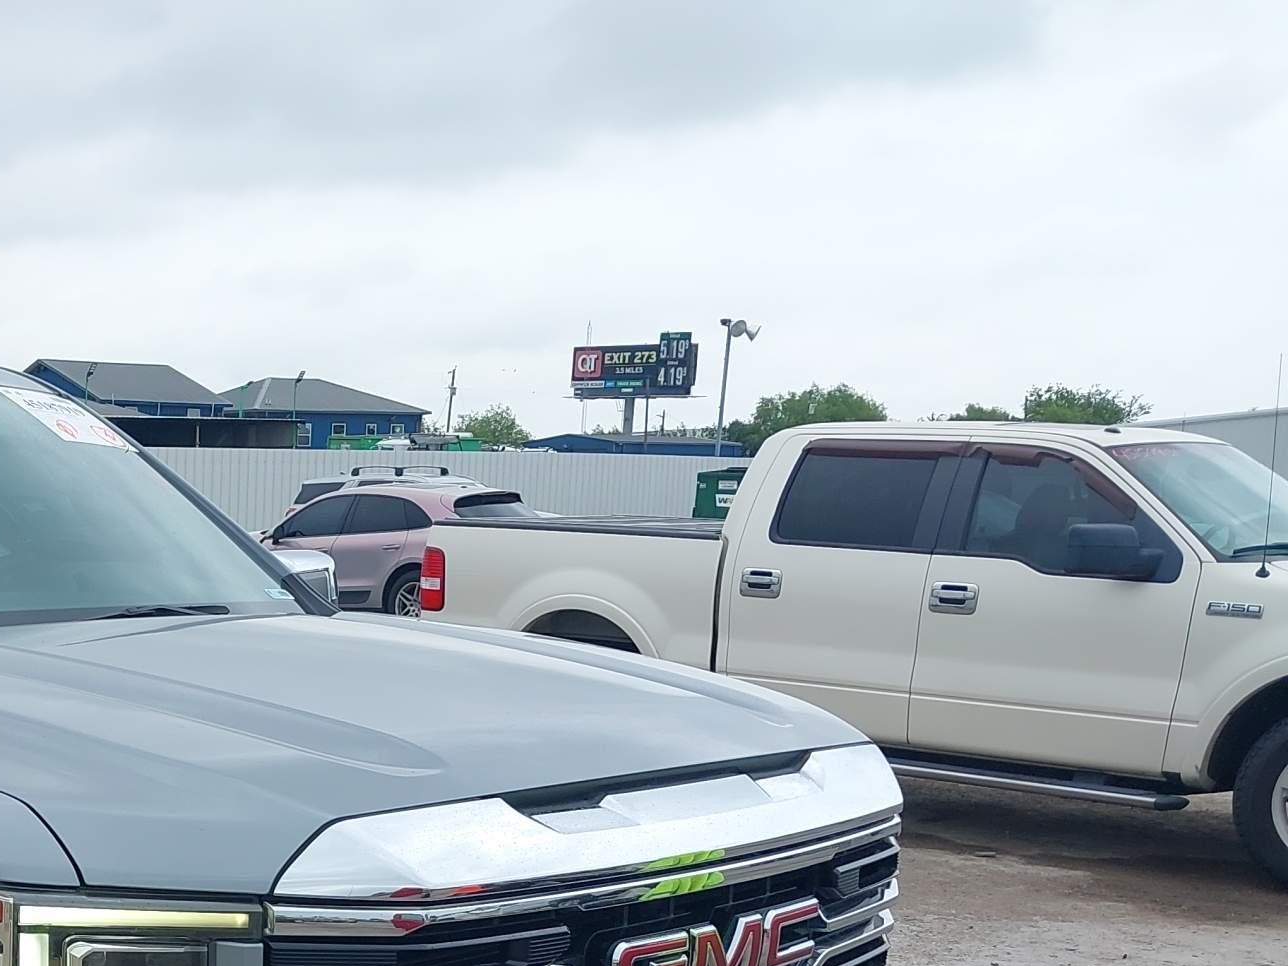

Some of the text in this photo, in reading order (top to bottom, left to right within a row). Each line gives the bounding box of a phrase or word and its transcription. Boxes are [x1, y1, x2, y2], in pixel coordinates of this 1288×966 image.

[577, 354, 598, 374] QT
[604, 351, 631, 364] EXIT
[633, 350, 657, 363] 273
